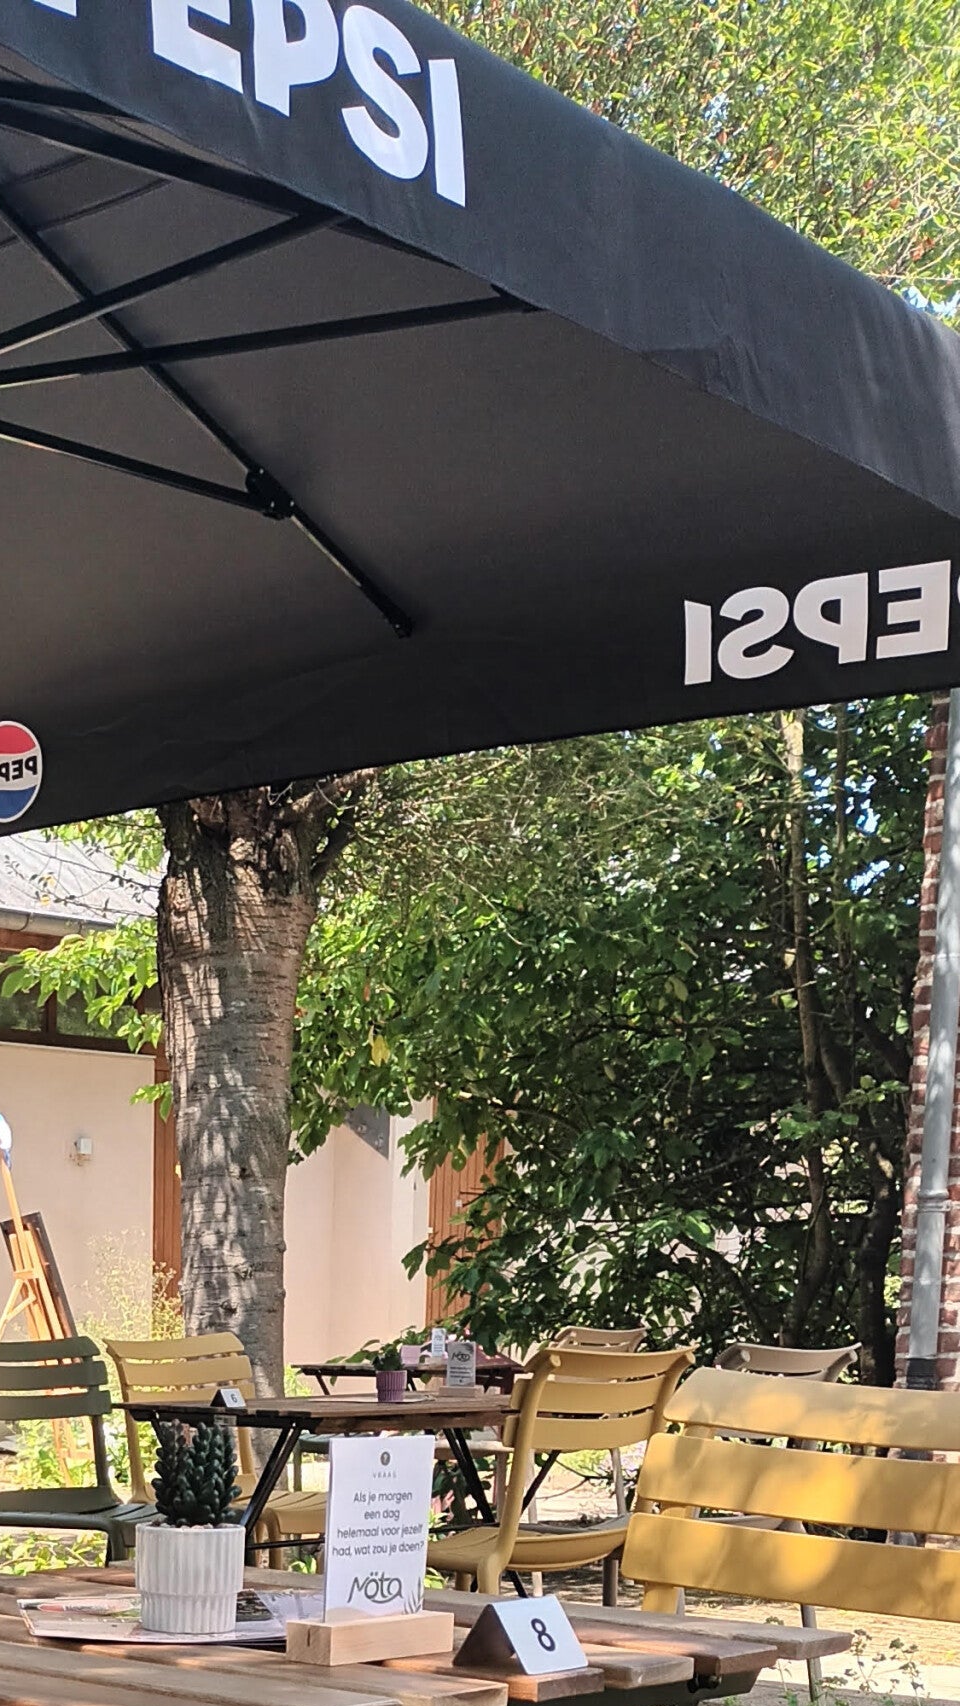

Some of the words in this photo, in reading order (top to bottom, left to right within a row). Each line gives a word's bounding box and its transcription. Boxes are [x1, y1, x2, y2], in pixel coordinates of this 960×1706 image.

[32, 0, 466, 207] EPSI
[230, 1393, 238, 1404] 6
[353, 1491, 367, 1503] Als
[367, 1491, 377, 1505] je
[378, 1490, 413, 1504] morgen
[363, 1510, 381, 1520] een
[382, 1508, 401, 1521] dag
[336, 1525, 380, 1539] helemaal
[380, 1526, 401, 1537] voor
[400, 1523, 424, 1538] jezelf
[331, 1545, 353, 1557] had,
[353, 1545, 371, 1556] wat
[371, 1545, 388, 1554] zou
[387, 1543, 398, 1556] je
[398, 1540, 425, 1553] doen?
[346, 1571, 404, 1604] Nöta
[530, 1617, 556, 1652] 8
